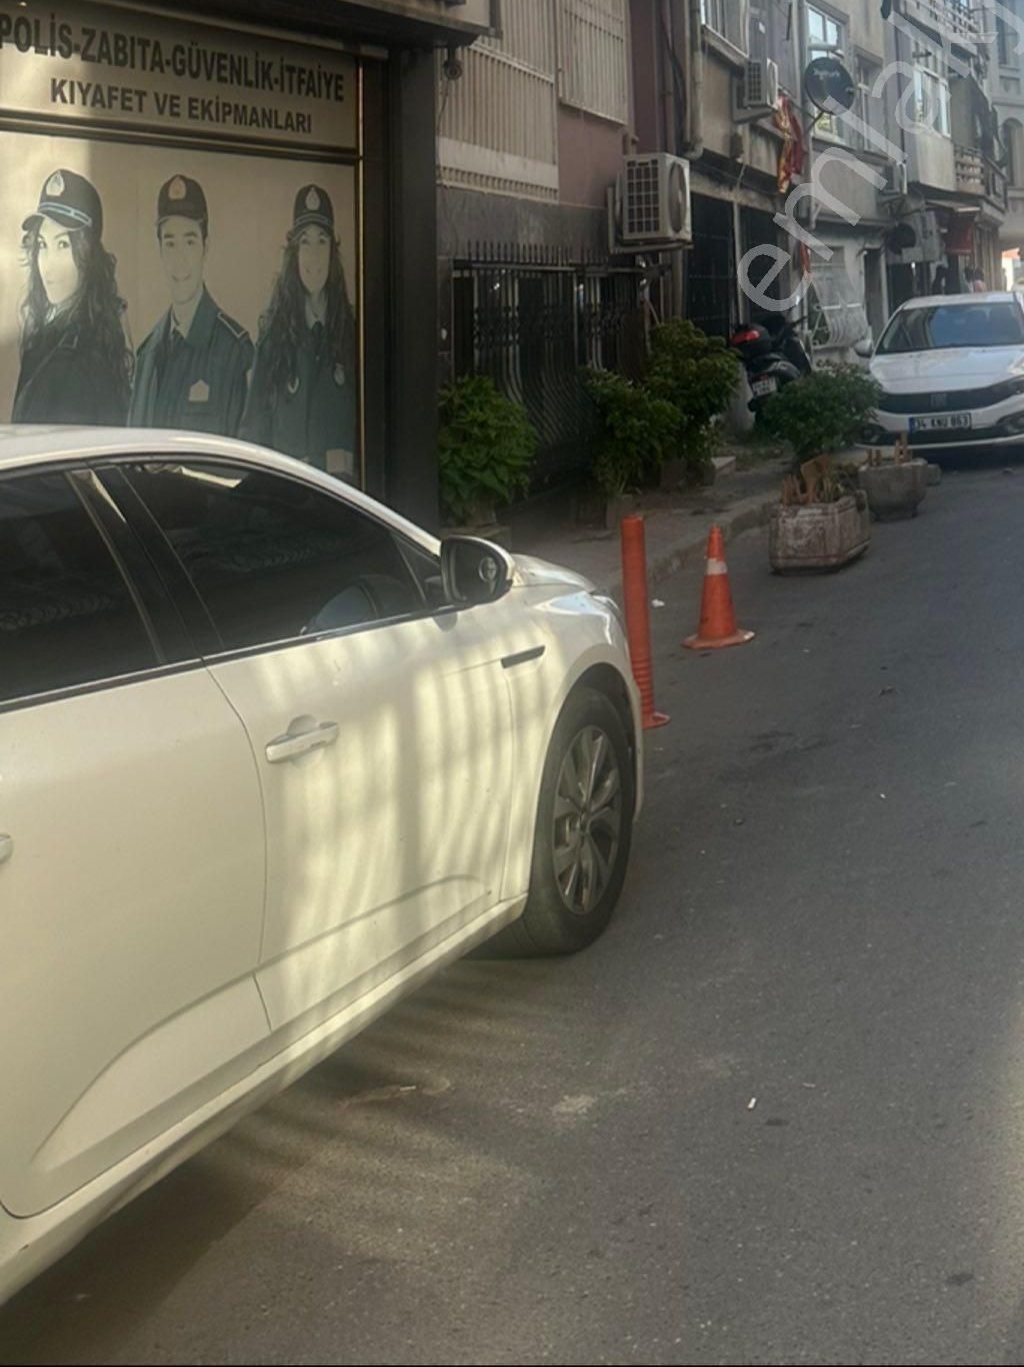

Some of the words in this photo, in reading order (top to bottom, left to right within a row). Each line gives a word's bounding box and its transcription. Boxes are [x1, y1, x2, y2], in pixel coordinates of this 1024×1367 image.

[50, 78, 147, 113] KIYAFET
[154, 91, 181, 118] VE
[188, 95, 312, 133] EKİPMANLARI
